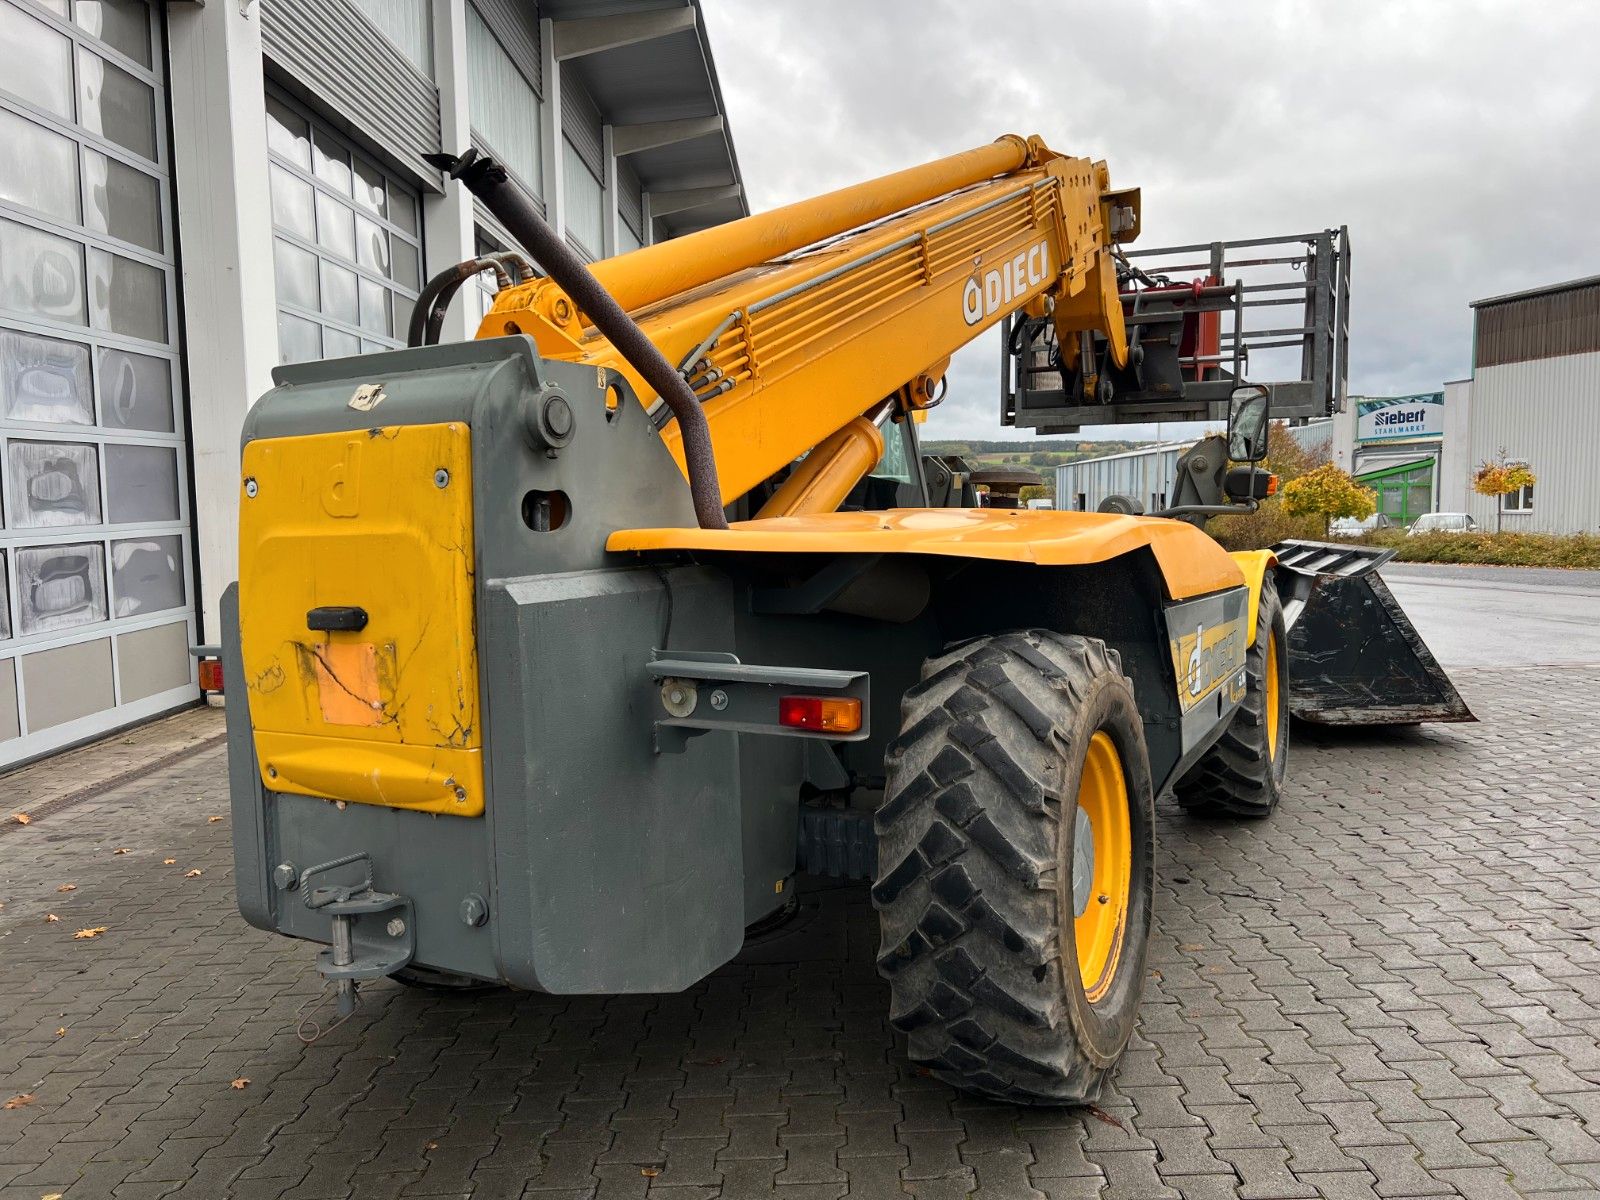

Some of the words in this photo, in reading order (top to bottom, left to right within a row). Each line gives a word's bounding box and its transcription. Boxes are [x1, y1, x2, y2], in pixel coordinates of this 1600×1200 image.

[985, 239, 1048, 316] DIECI
[1374, 408, 1426, 426] Siebert
[1374, 424, 1425, 435] STAHLMARKT
